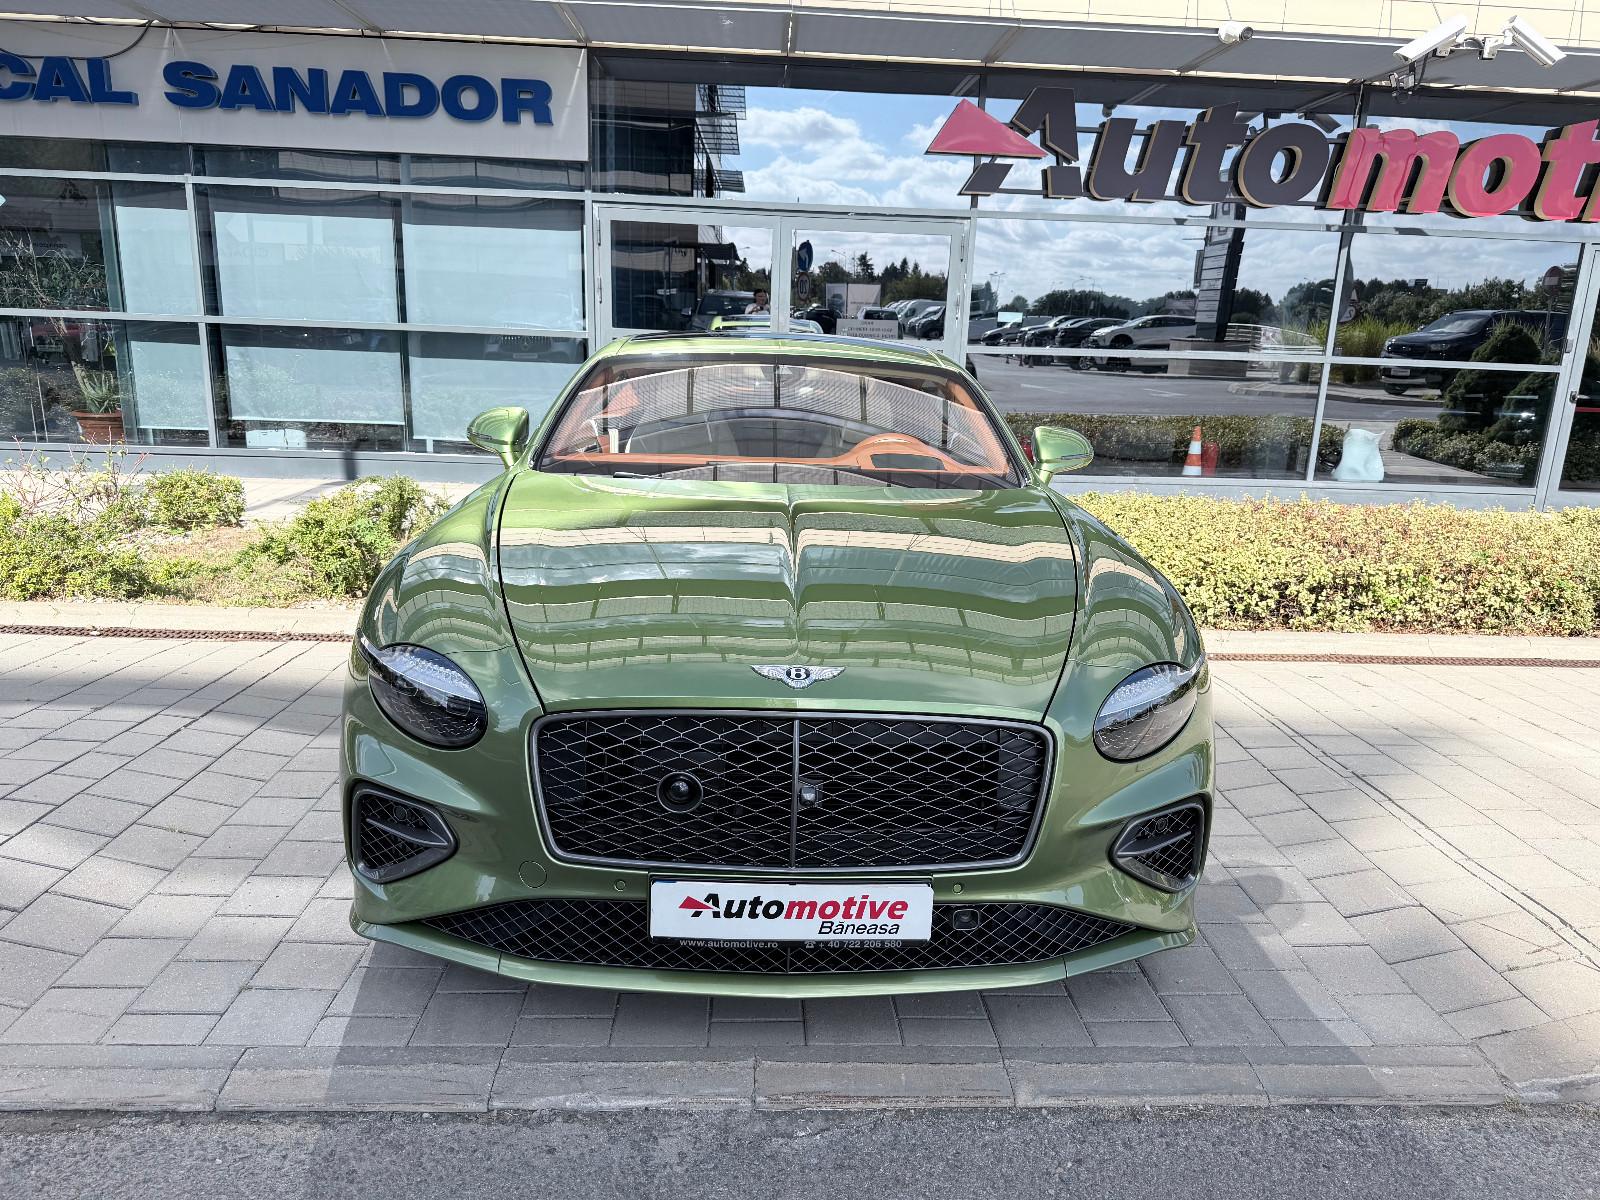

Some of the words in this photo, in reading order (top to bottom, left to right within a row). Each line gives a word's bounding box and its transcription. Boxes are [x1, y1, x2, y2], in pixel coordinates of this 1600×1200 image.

[163, 60, 553, 126] SANADOR
[927, 86, 1600, 222] Automot
[790, 667, 806, 680] B
[679, 893, 909, 920] Automotive
[818, 920, 900, 935] Băneasa
[679, 939, 779, 948] www.automotive.ro
[827, 940, 840, 948] 40
[843, 940, 861, 948] 722
[863, 940, 881, 948] 206
[884, 940, 902, 948] 580
